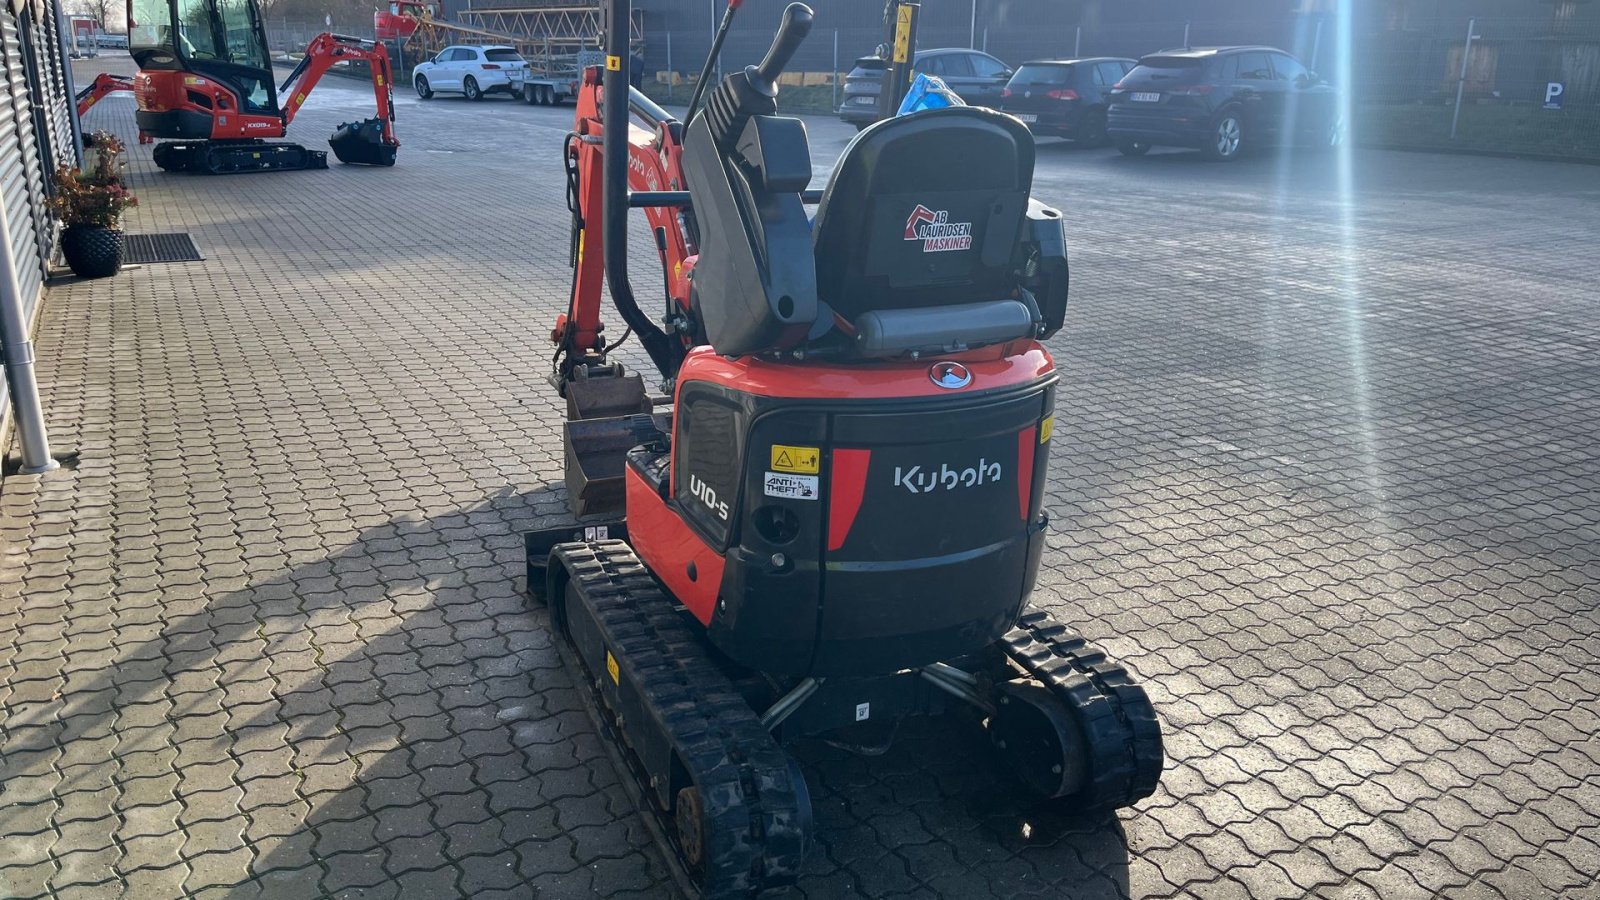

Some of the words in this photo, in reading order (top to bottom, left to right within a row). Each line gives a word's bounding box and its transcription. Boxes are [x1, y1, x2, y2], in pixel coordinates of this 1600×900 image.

[1545, 82, 1563, 103] P
[933, 211, 947, 224] AB
[920, 223, 971, 239] LAURIDSEN
[924, 236, 971, 252] MASKINER
[767, 477, 792, 487] ANTI
[894, 458, 1002, 493] Kubota
[766, 483, 797, 494] THEFT
[690, 474, 729, 521] U10-5
